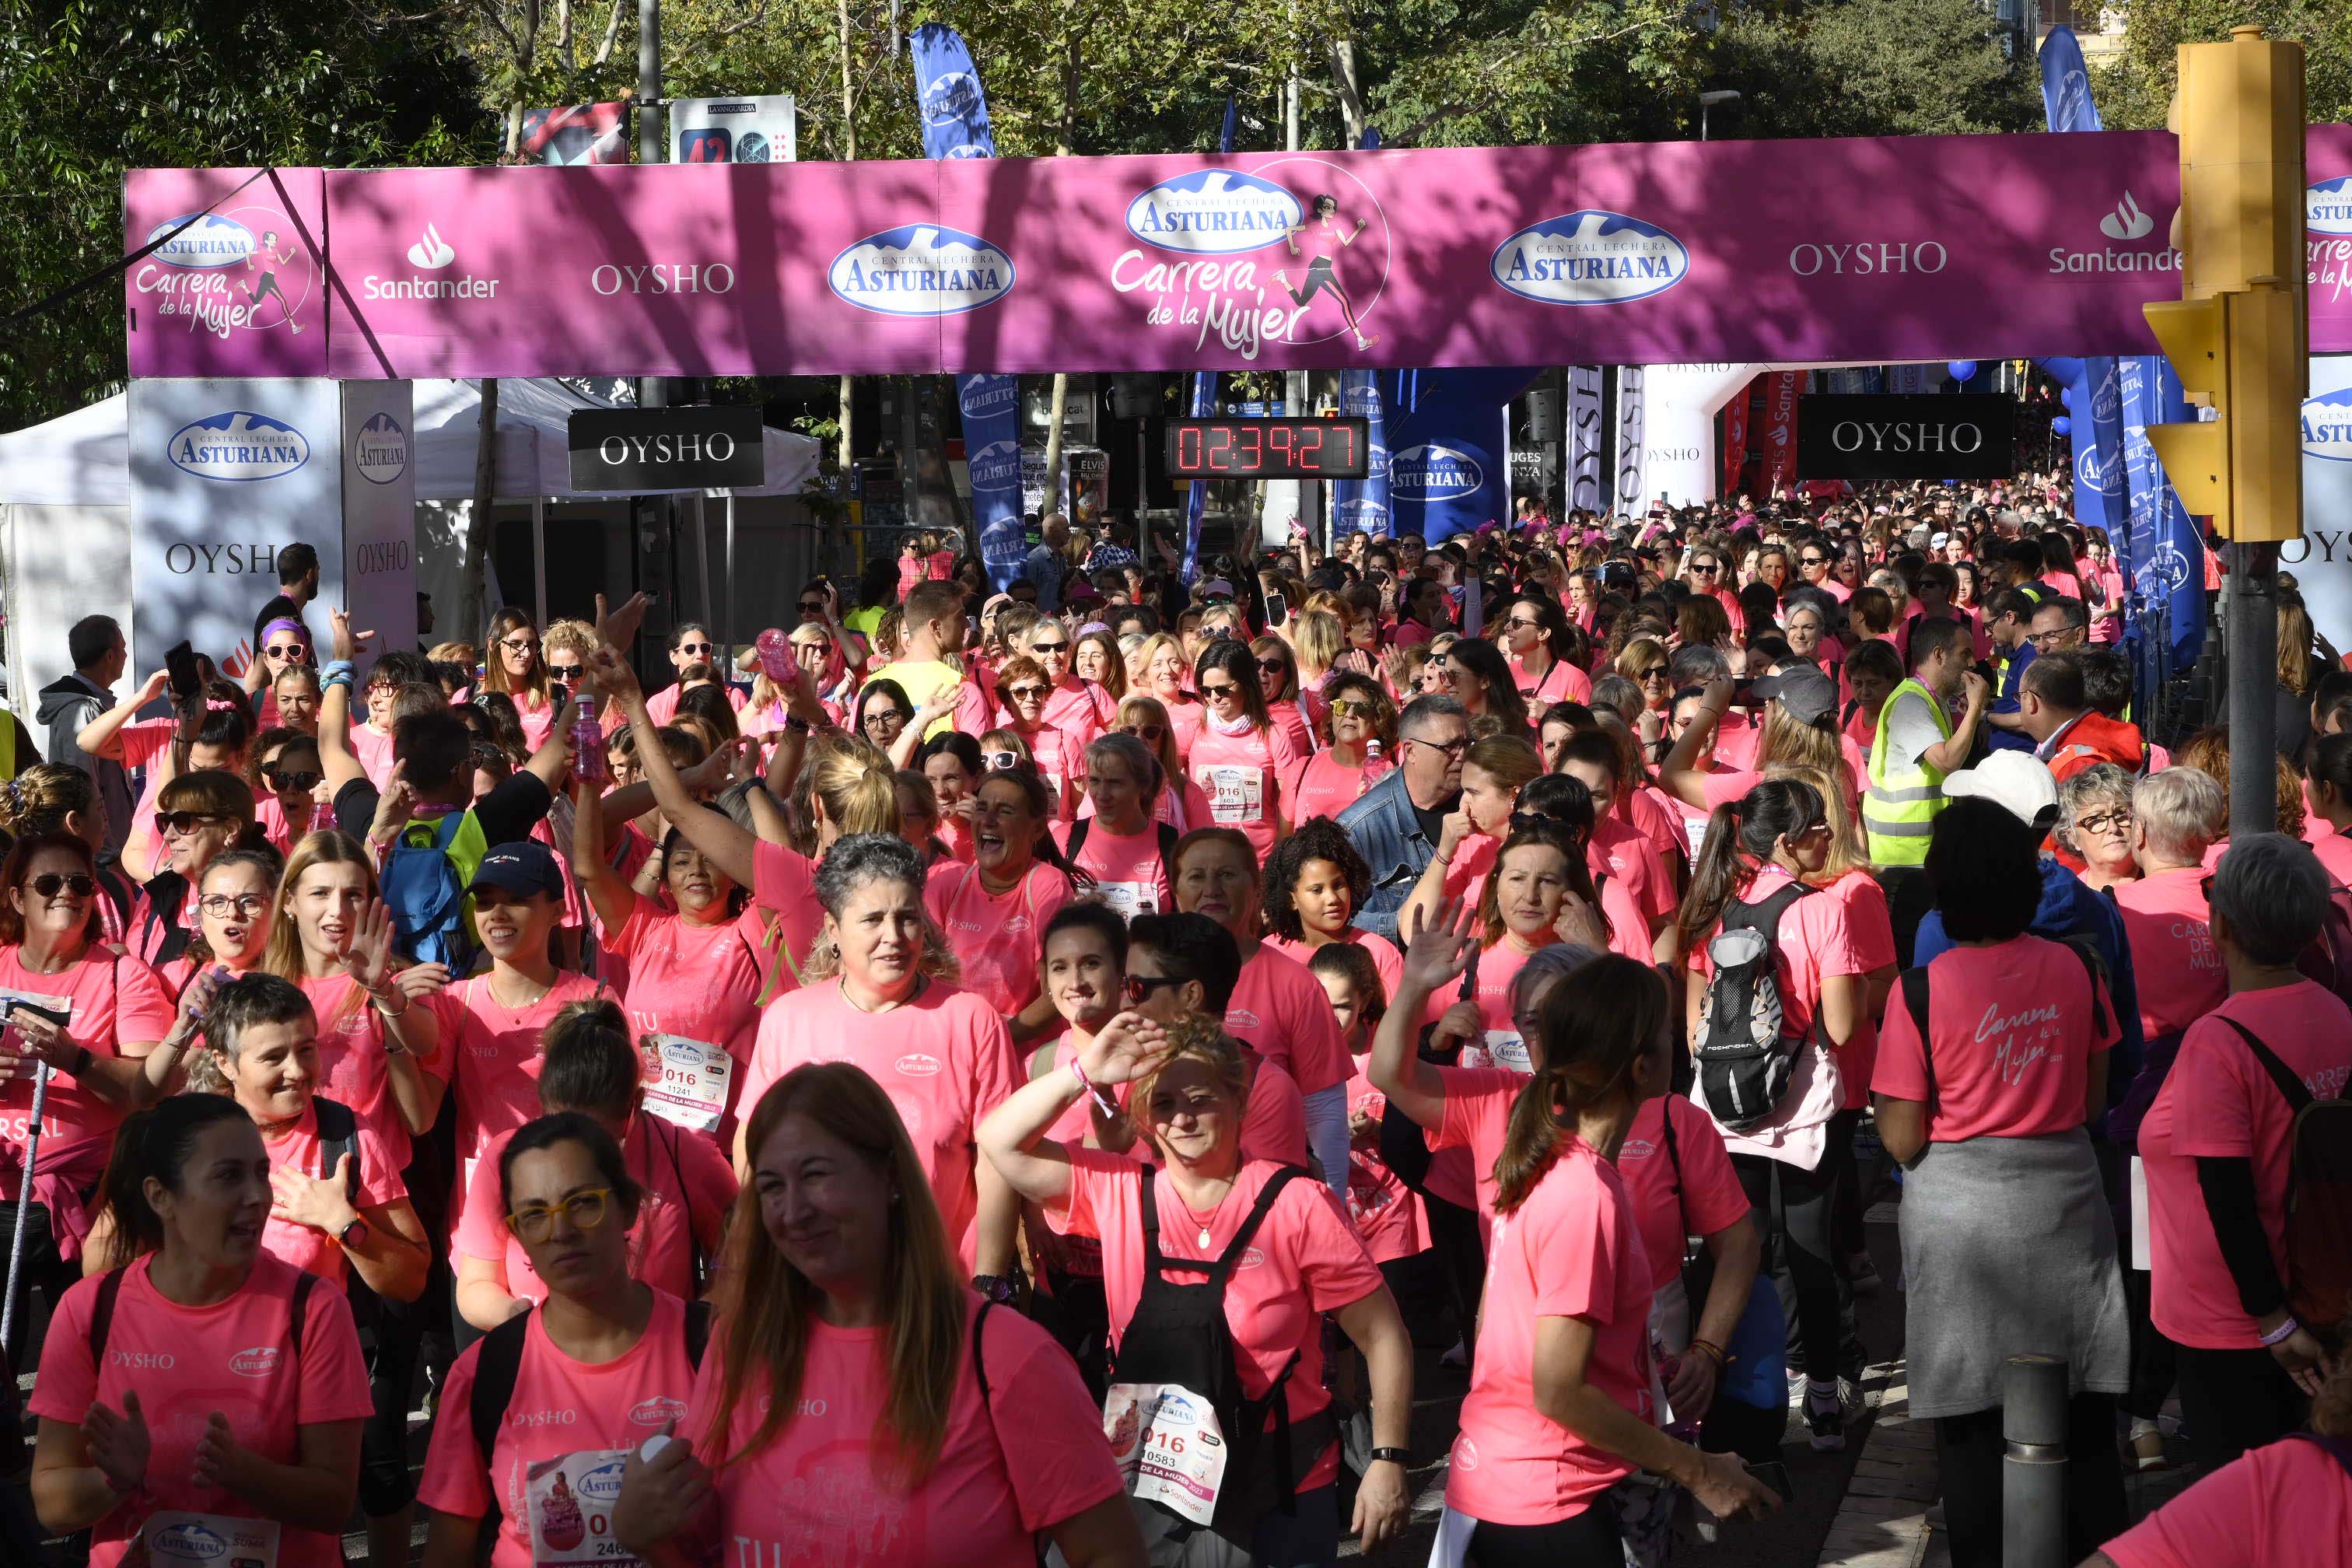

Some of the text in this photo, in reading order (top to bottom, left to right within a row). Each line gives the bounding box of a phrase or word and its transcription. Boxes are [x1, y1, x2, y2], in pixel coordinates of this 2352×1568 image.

[1167, 198, 1285, 207] CENTRAL LECHERA
[1139, 200, 1290, 233] ASTURIANA
[872, 255, 996, 265] CENTRAL LECHERA
[1537, 242, 1668, 254] CENTRAL LECHERA
[1790, 241, 1948, 276] OYSHO
[2049, 247, 2182, 274] Santande
[843, 258, 1001, 292] ASTURIANA
[1111, 249, 1256, 293] Carrera
[1506, 247, 1674, 282] ASTURIANA
[137, 264, 228, 293] Carrera
[364, 275, 499, 299] Santander
[591, 263, 735, 295] OYSHO
[159, 290, 261, 339] de la Mujer
[1147, 289, 1312, 361] de la Mujer
[178, 437, 299, 464] ASTURIANA
[600, 432, 736, 466] OYSHO
[1179, 427, 1352, 469] 02:39:27
[1831, 421, 1983, 453] OYSHO
[359, 440, 404, 467] ASTURIANA
[1081, 460, 1104, 470] ELVIS
[165, 543, 278, 574] OYSH
[356, 541, 408, 575] OYSHO
[1219, 787, 1240, 796] 016
[632, 1011, 658, 1031] TU
[667, 1049, 701, 1063] ASTURIANA
[666, 1069, 696, 1086] 016
[667, 1085, 691, 1096] 11241
[1140, 1426, 1186, 1453] 016
[1143, 1448, 1175, 1468] 10583
[584, 1479, 622, 1493] ASTUR
[1165, 1471, 1188, 1486] MUJER
[1188, 1482, 1203, 1495] 2023
[1170, 1488, 1203, 1514] Santander
[160, 1535, 219, 1555] ASTURIANA
